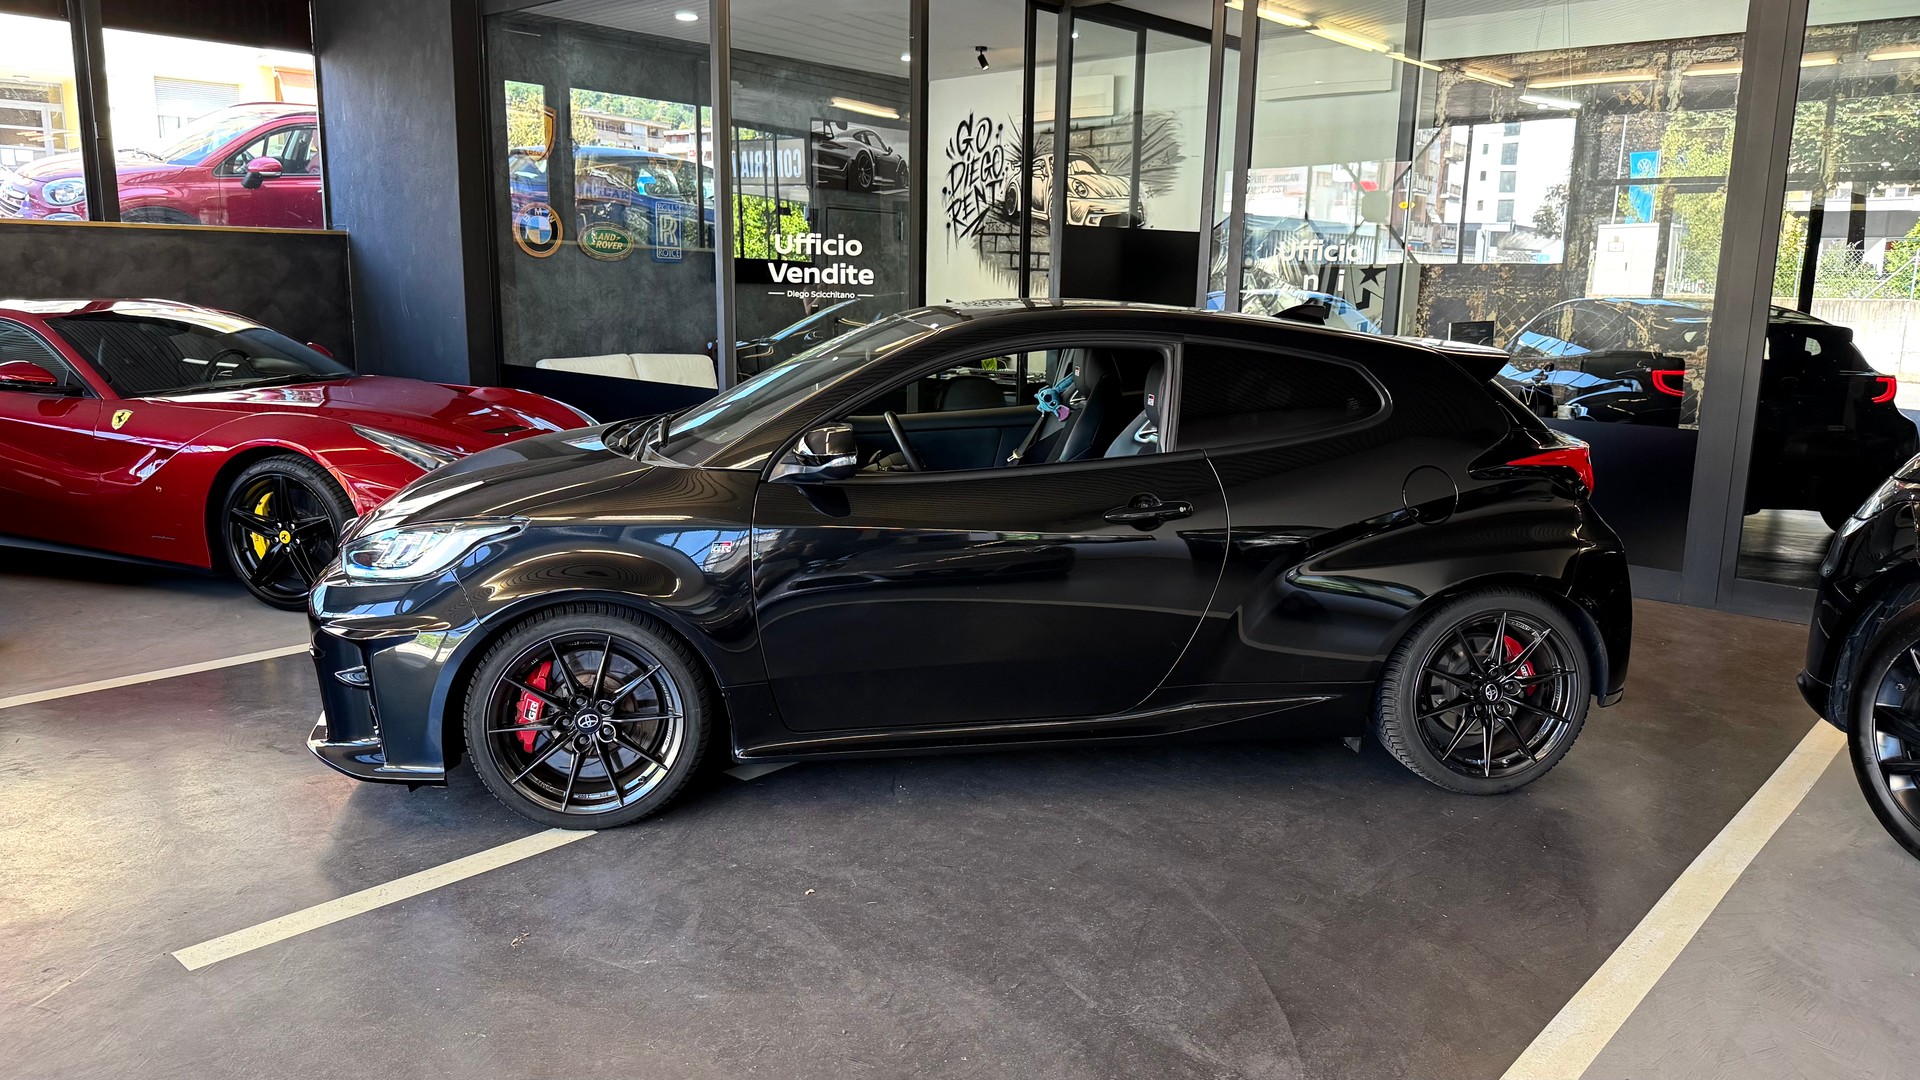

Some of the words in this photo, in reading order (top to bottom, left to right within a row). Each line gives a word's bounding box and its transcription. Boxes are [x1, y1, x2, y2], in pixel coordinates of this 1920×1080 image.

[956, 112, 993, 156] GO
[657, 203, 680, 212] ROLLS
[946, 179, 1003, 228] RENT
[522, 206, 557, 224] BMW
[593, 231, 617, 241] LAND
[595, 241, 624, 250] ROVER
[774, 232, 863, 256] Ufficio
[1278, 238, 1363, 263] Ufficio
[767, 262, 875, 285] Vendite
[786, 290, 809, 299] Diego
[810, 290, 856, 299] Scicchitano
